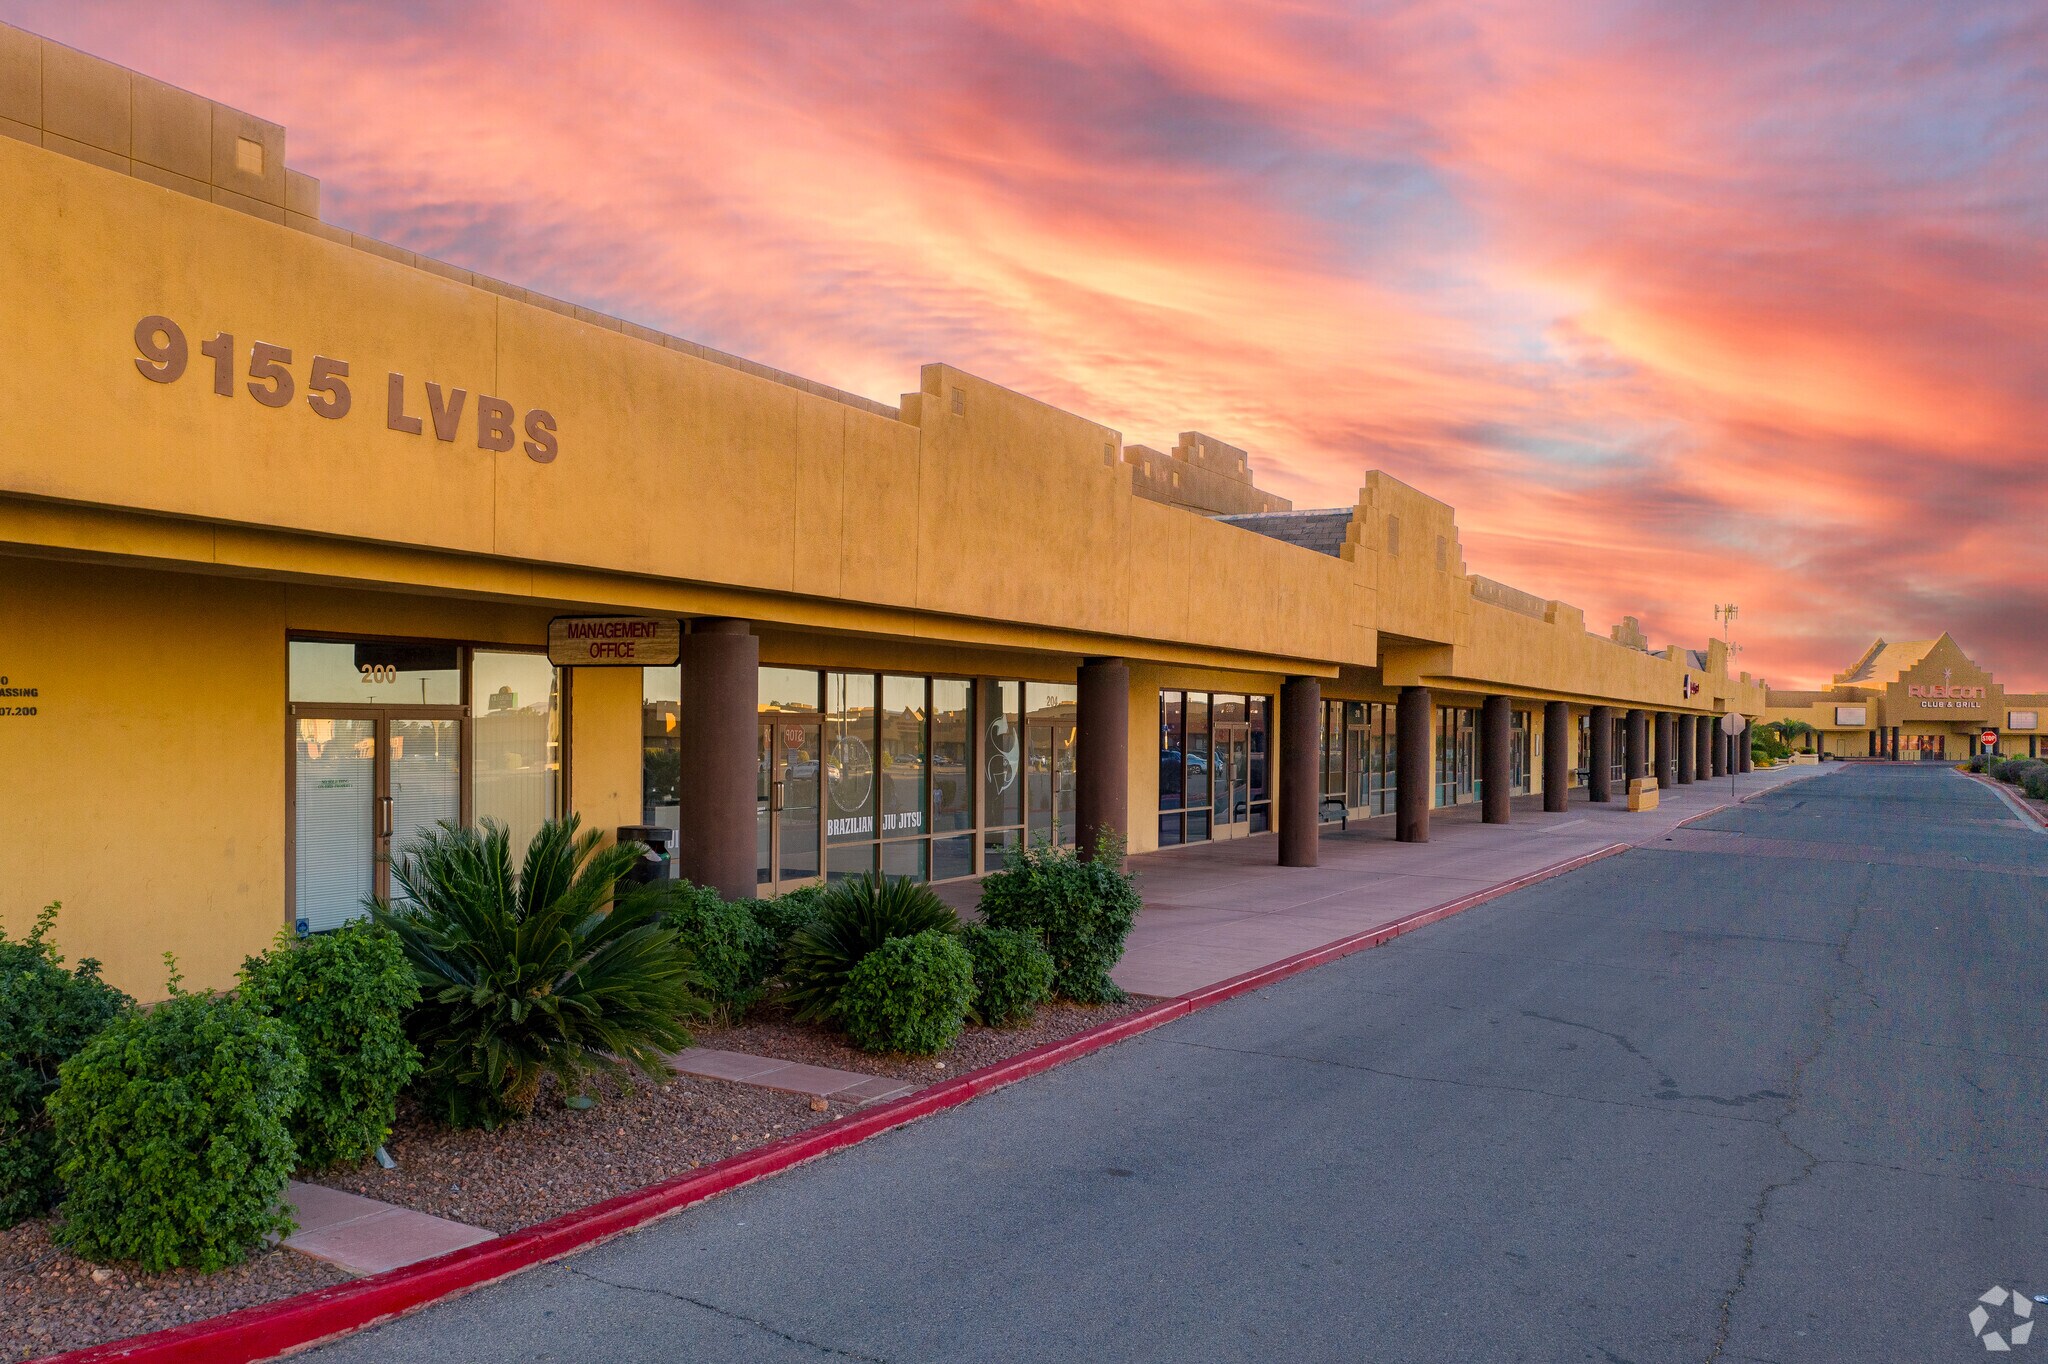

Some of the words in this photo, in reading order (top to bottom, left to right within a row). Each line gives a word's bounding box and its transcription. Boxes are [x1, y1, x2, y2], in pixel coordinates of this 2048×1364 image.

[134, 315, 352, 420] 9155
[387, 371, 559, 464] LVBS
[567, 621, 660, 639] MANAGEMENT
[589, 642, 635, 658] OFFICE
[361, 663, 397, 685] 200
[827, 816, 874, 836] BRAZILIAN
[882, 814, 897, 831] JIU
[898, 812, 922, 829] JITSU
